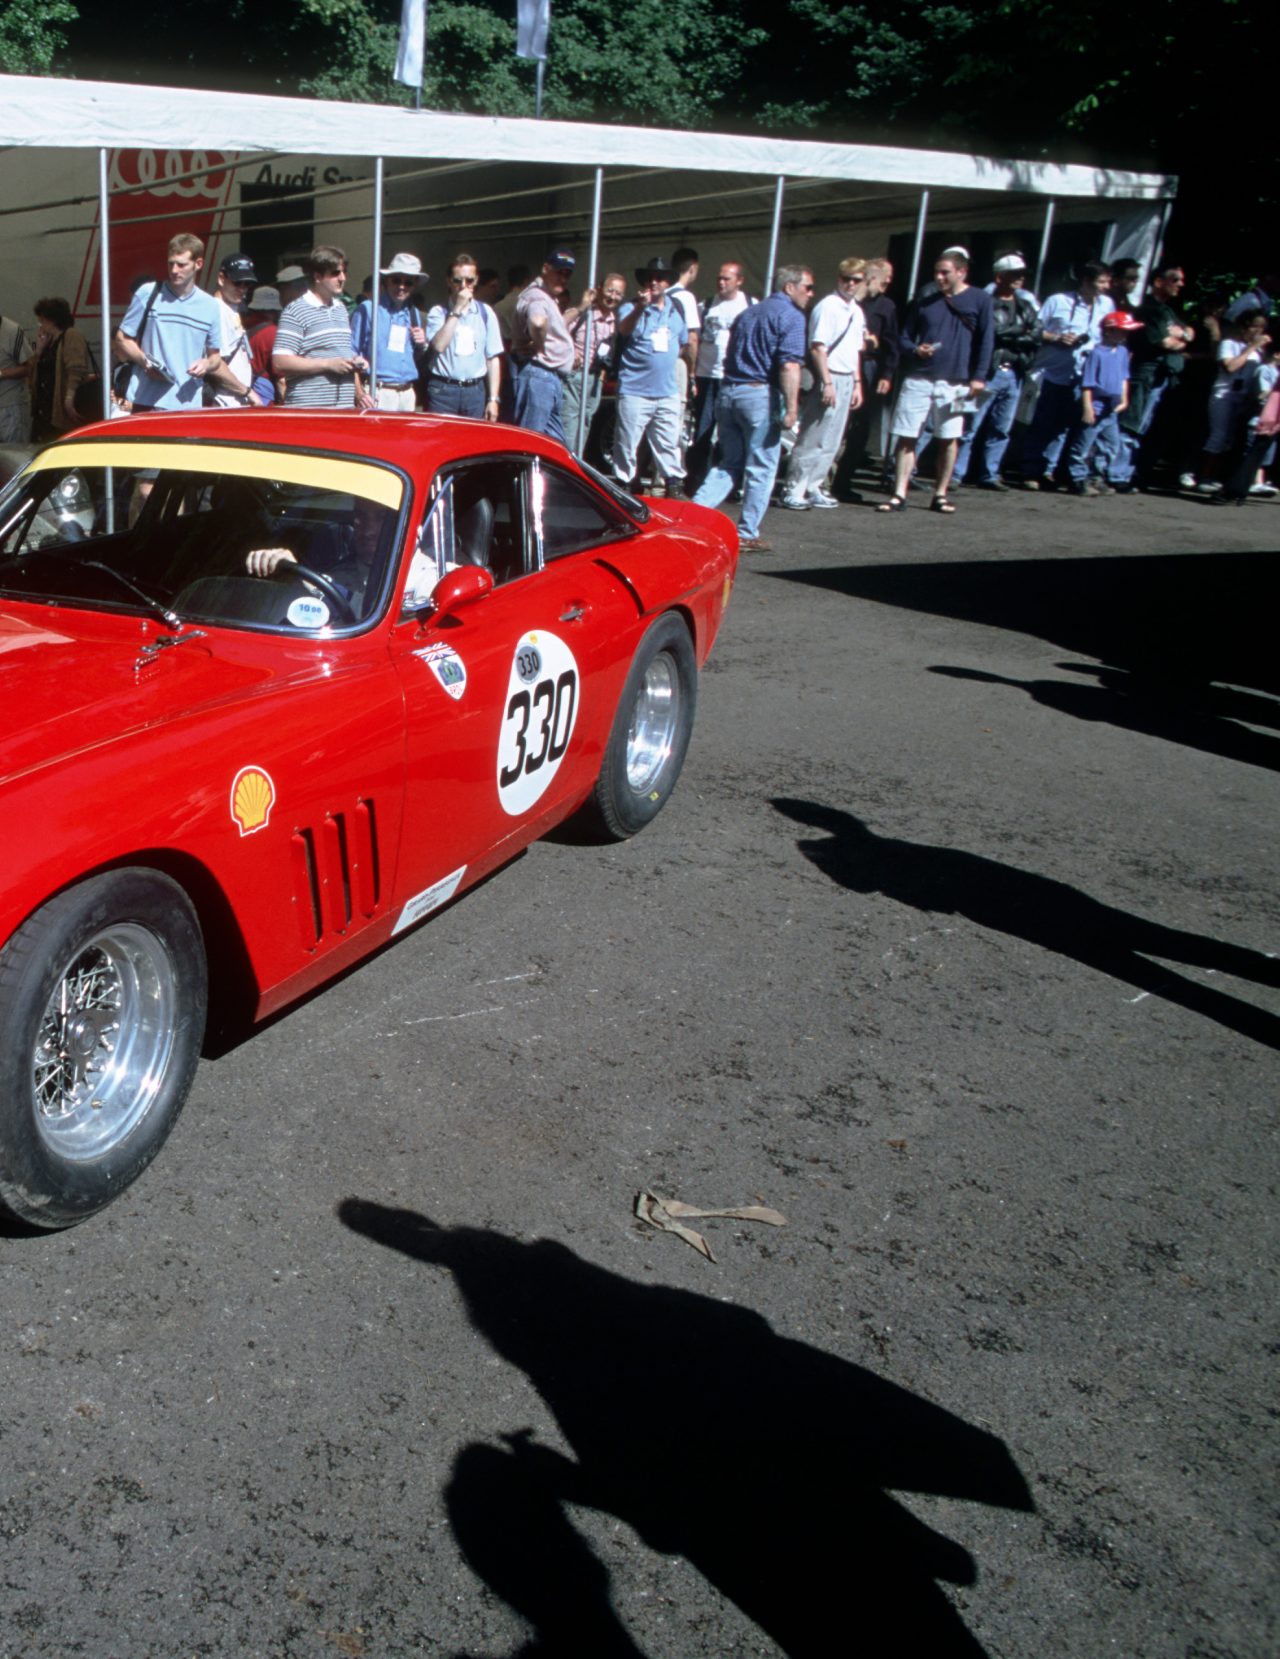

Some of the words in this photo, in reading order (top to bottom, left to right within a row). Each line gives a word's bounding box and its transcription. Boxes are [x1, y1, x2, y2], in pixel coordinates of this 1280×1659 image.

[255, 164, 317, 186] Audi
[517, 651, 539, 677] 330
[500, 669, 576, 788] 330
